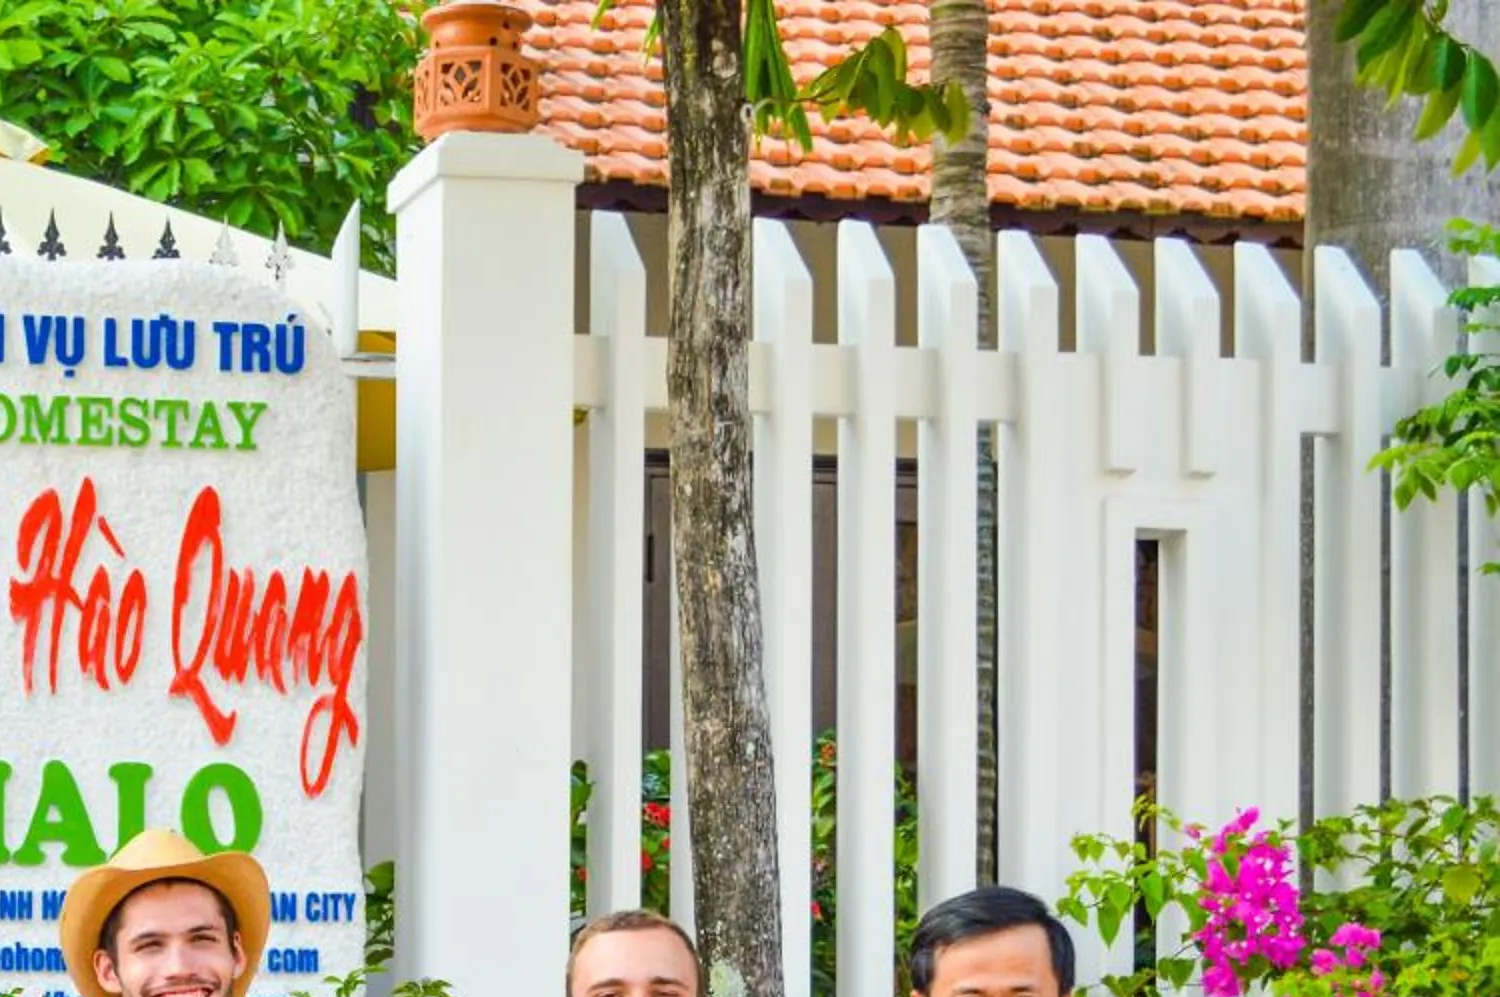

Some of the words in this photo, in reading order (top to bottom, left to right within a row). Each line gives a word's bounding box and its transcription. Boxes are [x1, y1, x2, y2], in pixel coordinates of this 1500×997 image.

[22, 314, 86, 378] VỤ
[103, 313, 197, 370] LƯU
[212, 314, 306, 375] TRÚ
[9, 476, 148, 695] Hào
[168, 485, 364, 799] Quang
[40, 889, 68, 921] H
[304, 891, 357, 923] CITY
